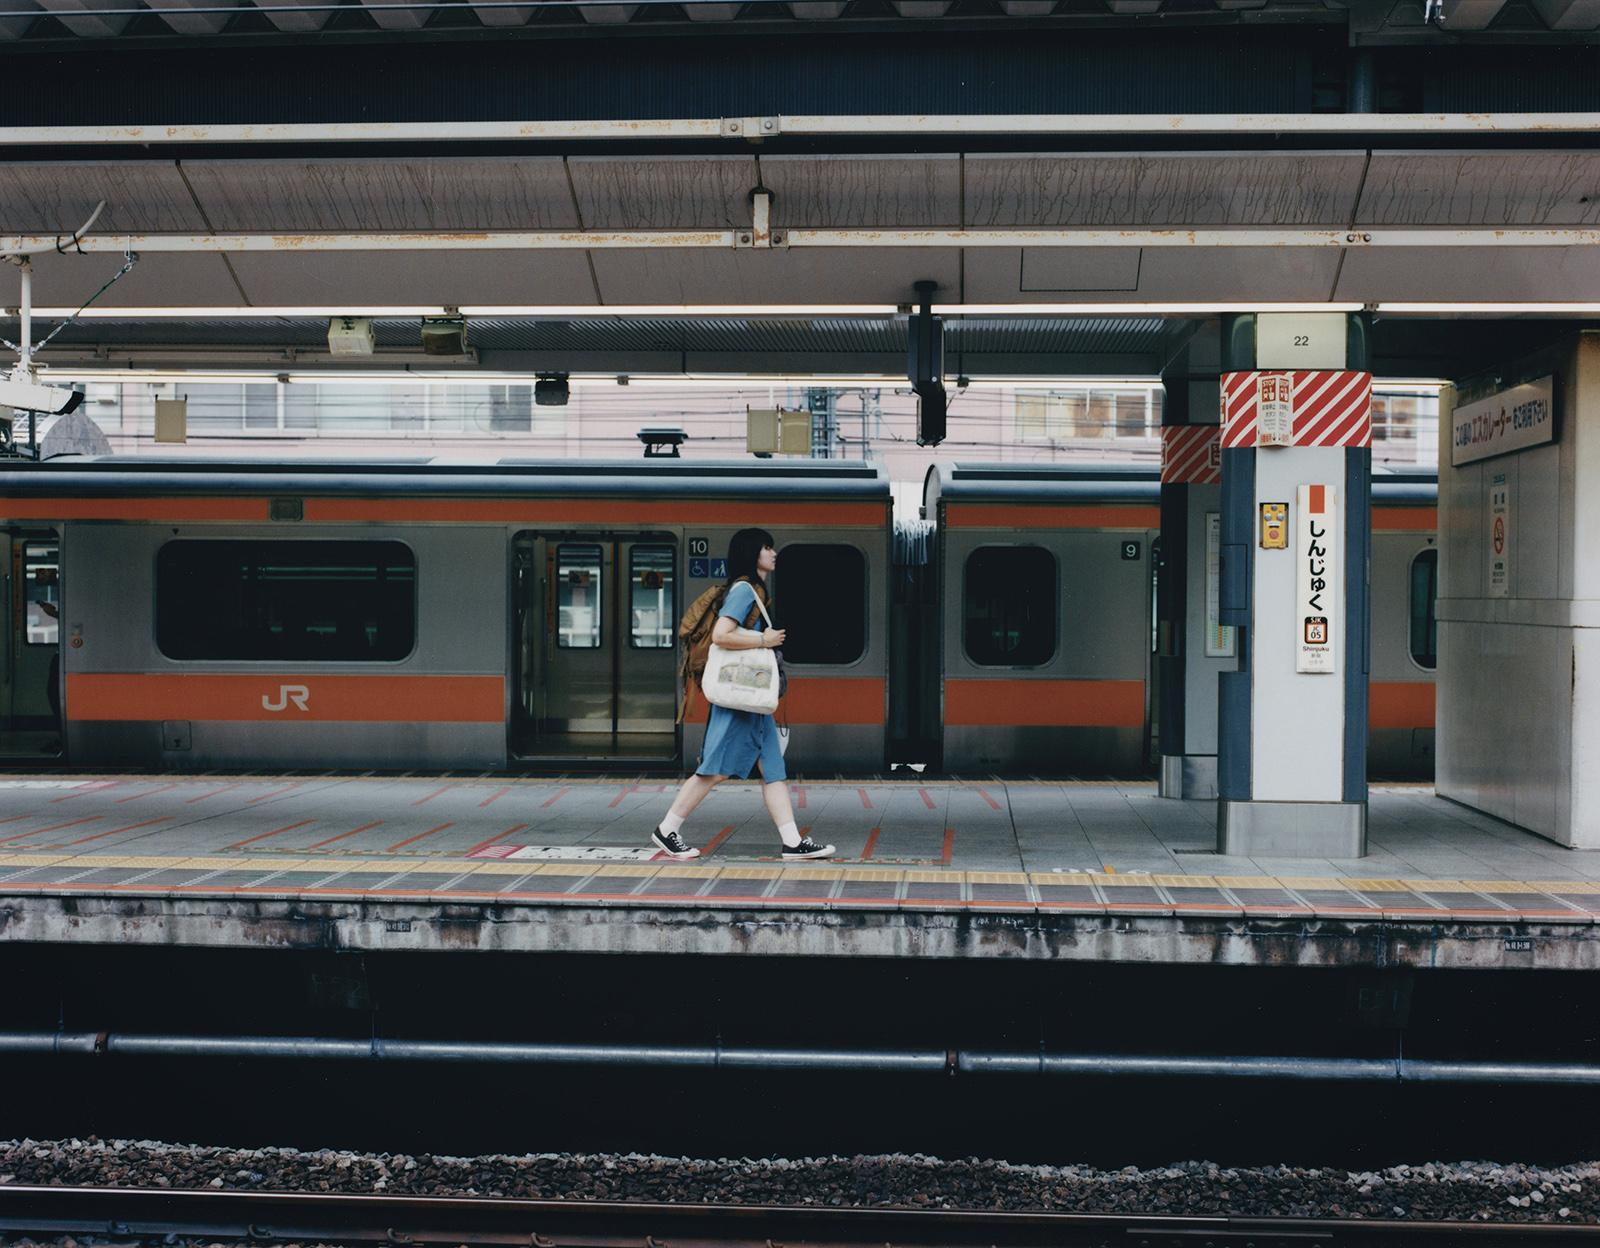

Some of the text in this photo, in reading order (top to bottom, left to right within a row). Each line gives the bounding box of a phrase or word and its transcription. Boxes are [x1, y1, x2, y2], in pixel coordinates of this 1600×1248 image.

[1294, 335, 1309, 346] 22
[1262, 380, 1276, 388] STOP
[690, 540, 707, 554] 10
[1126, 544, 1136, 557] 9
[1307, 520, 1326, 612] しんじゅく
[1310, 631, 1322, 639] 05
[262, 685, 310, 711] JR
